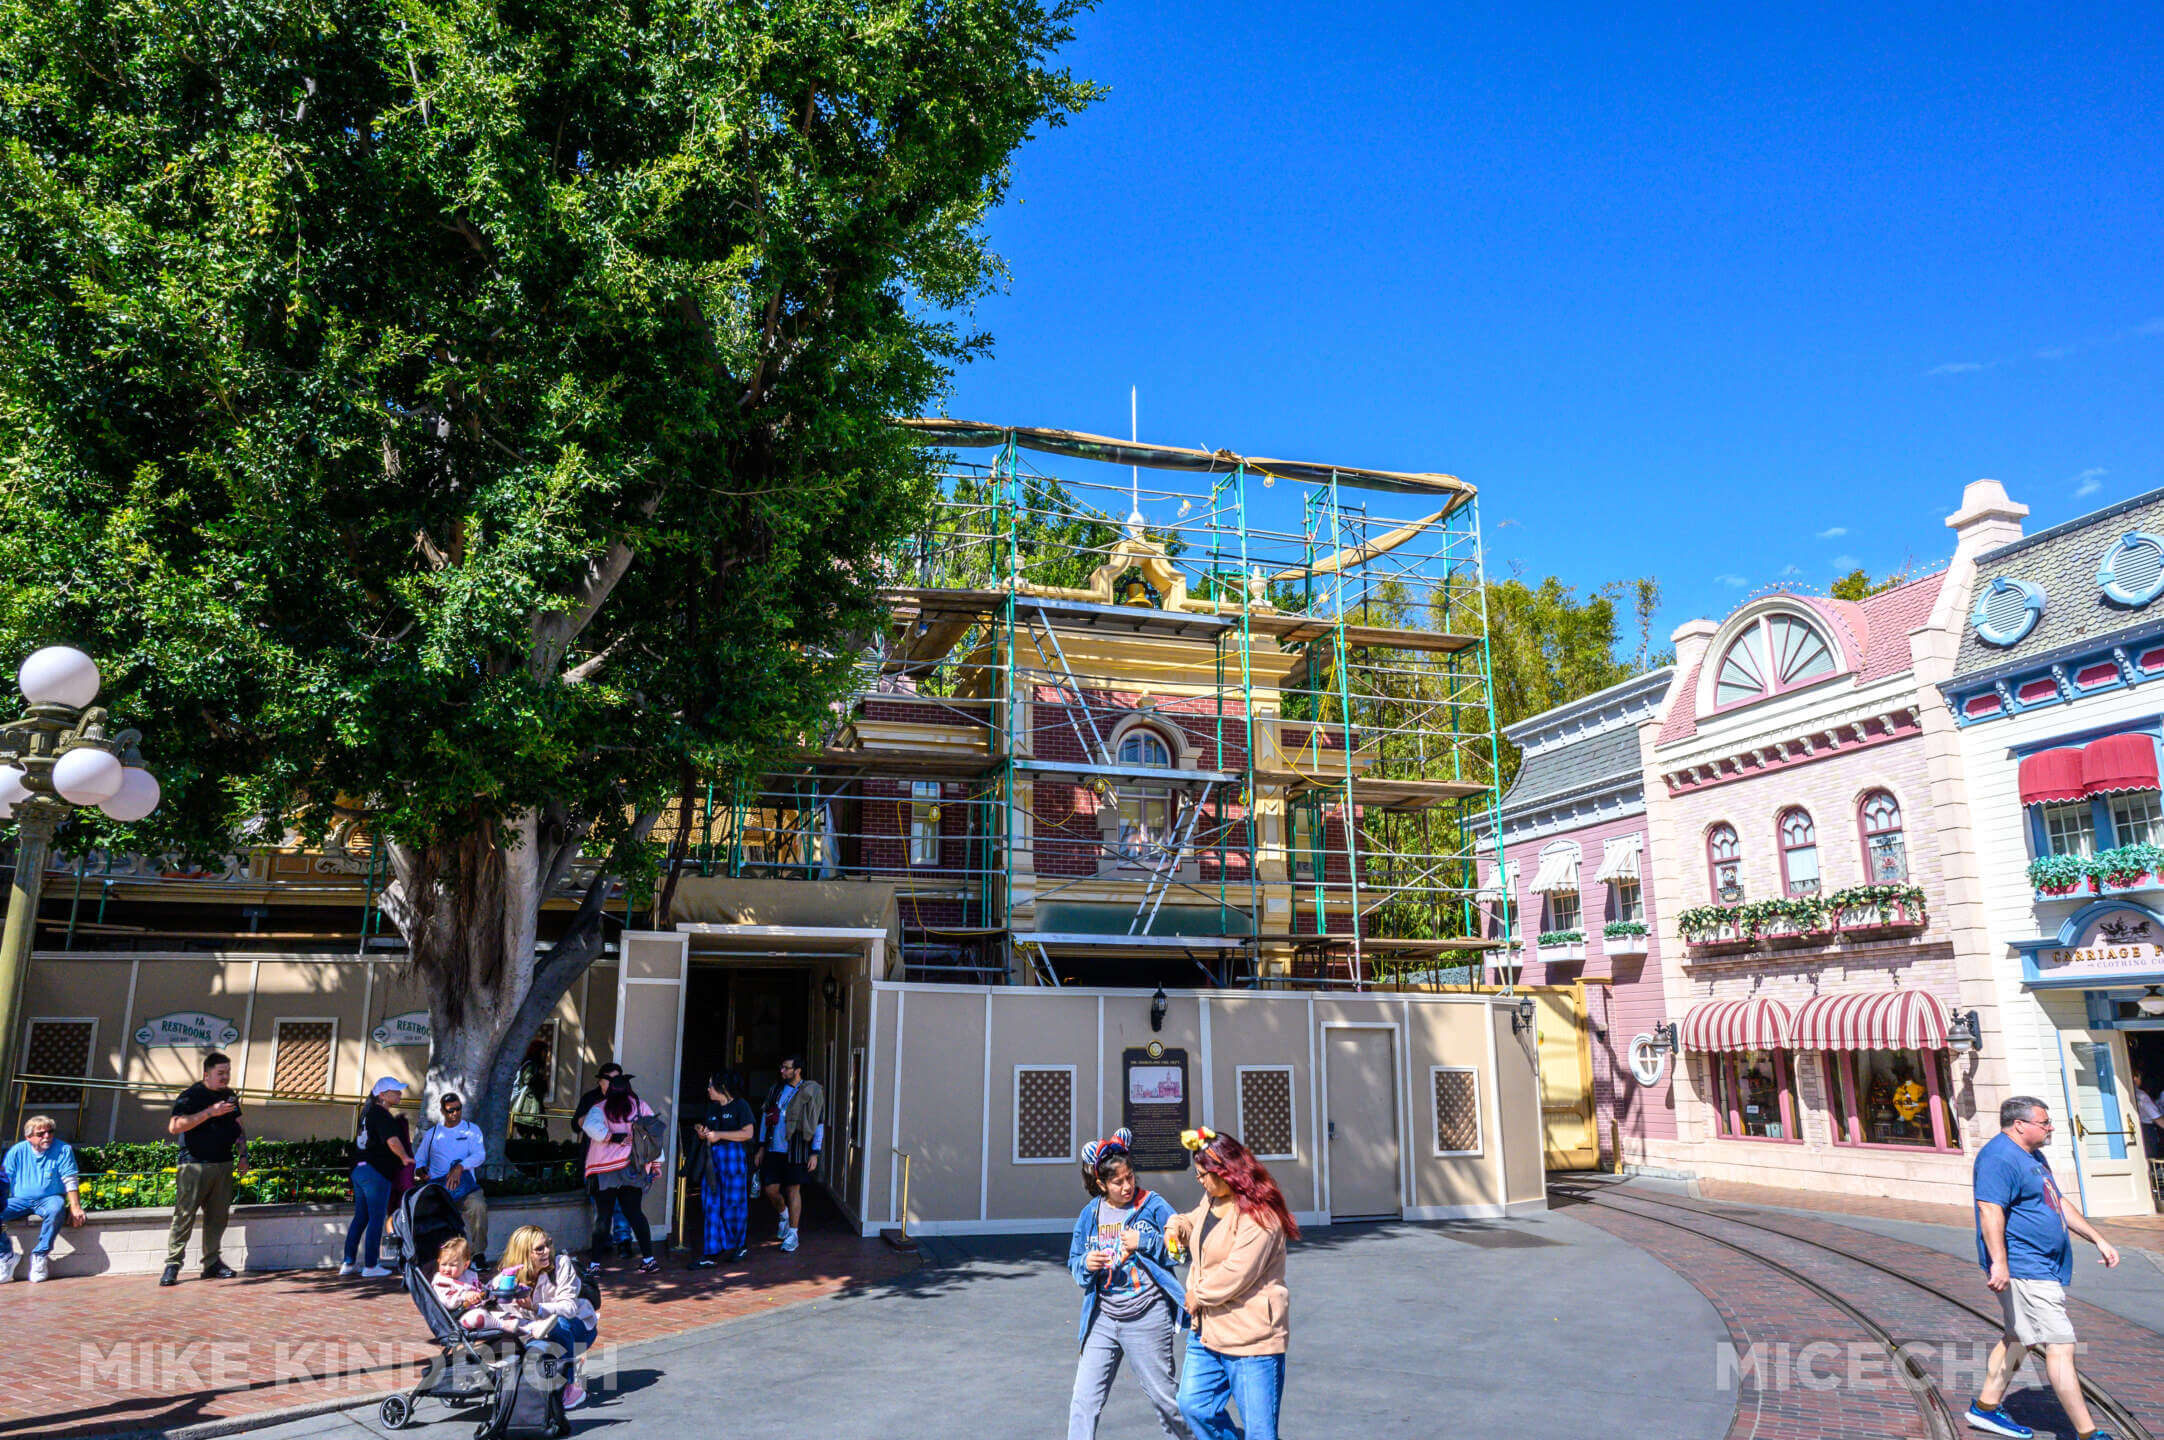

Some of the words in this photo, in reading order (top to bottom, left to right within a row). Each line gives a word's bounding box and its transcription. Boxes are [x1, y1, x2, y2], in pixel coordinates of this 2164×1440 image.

[2052, 946, 2141, 963] CARRIAGE
[2096, 959, 2146, 969] CLOTHING
[161, 1019, 212, 1041] RESTROOMS
[396, 1019, 431, 1038] RESTROO
